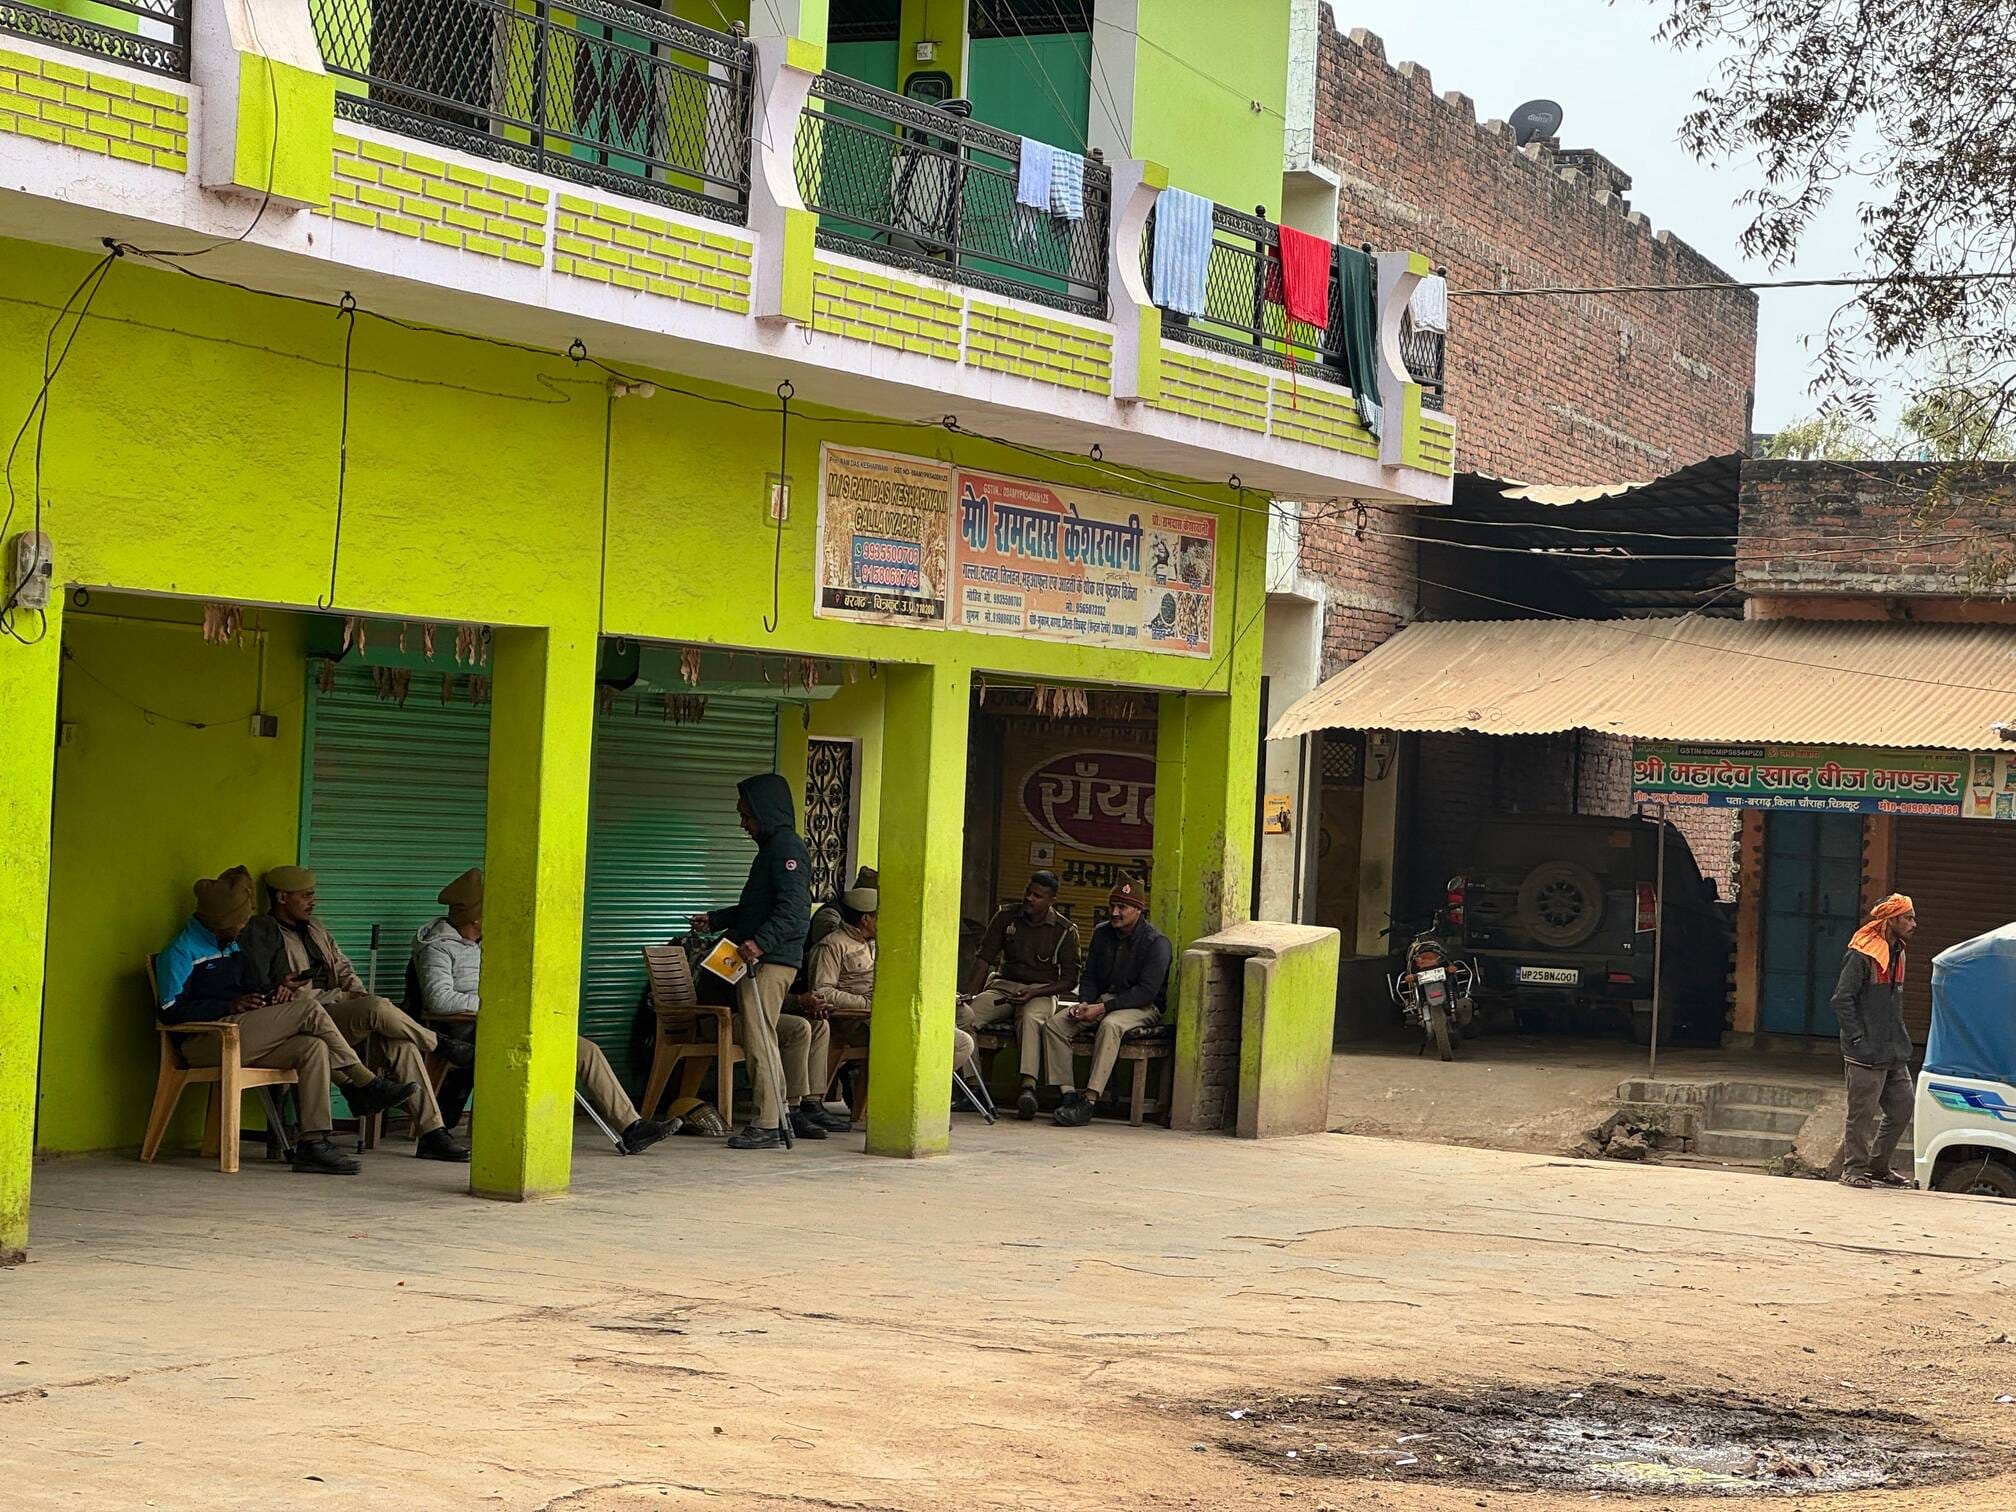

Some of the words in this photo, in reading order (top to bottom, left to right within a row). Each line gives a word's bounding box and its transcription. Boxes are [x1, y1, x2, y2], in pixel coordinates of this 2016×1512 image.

[850, 476, 872, 502] RAM
[872, 479, 890, 505] DAS
[891, 482, 947, 513] KESHARWANI
[855, 507, 884, 533] GALLA
[884, 511, 921, 539] VYAPARI
[993, 503, 1061, 561] रामदास
[1063, 502, 1143, 572] केशरवानी
[1634, 755, 1664, 784] श्री
[1670, 759, 1752, 788] महादेव
[1757, 765, 1812, 790] खाद
[1817, 762, 1867, 791] बीज
[1872, 768, 1960, 795] भण्डार
